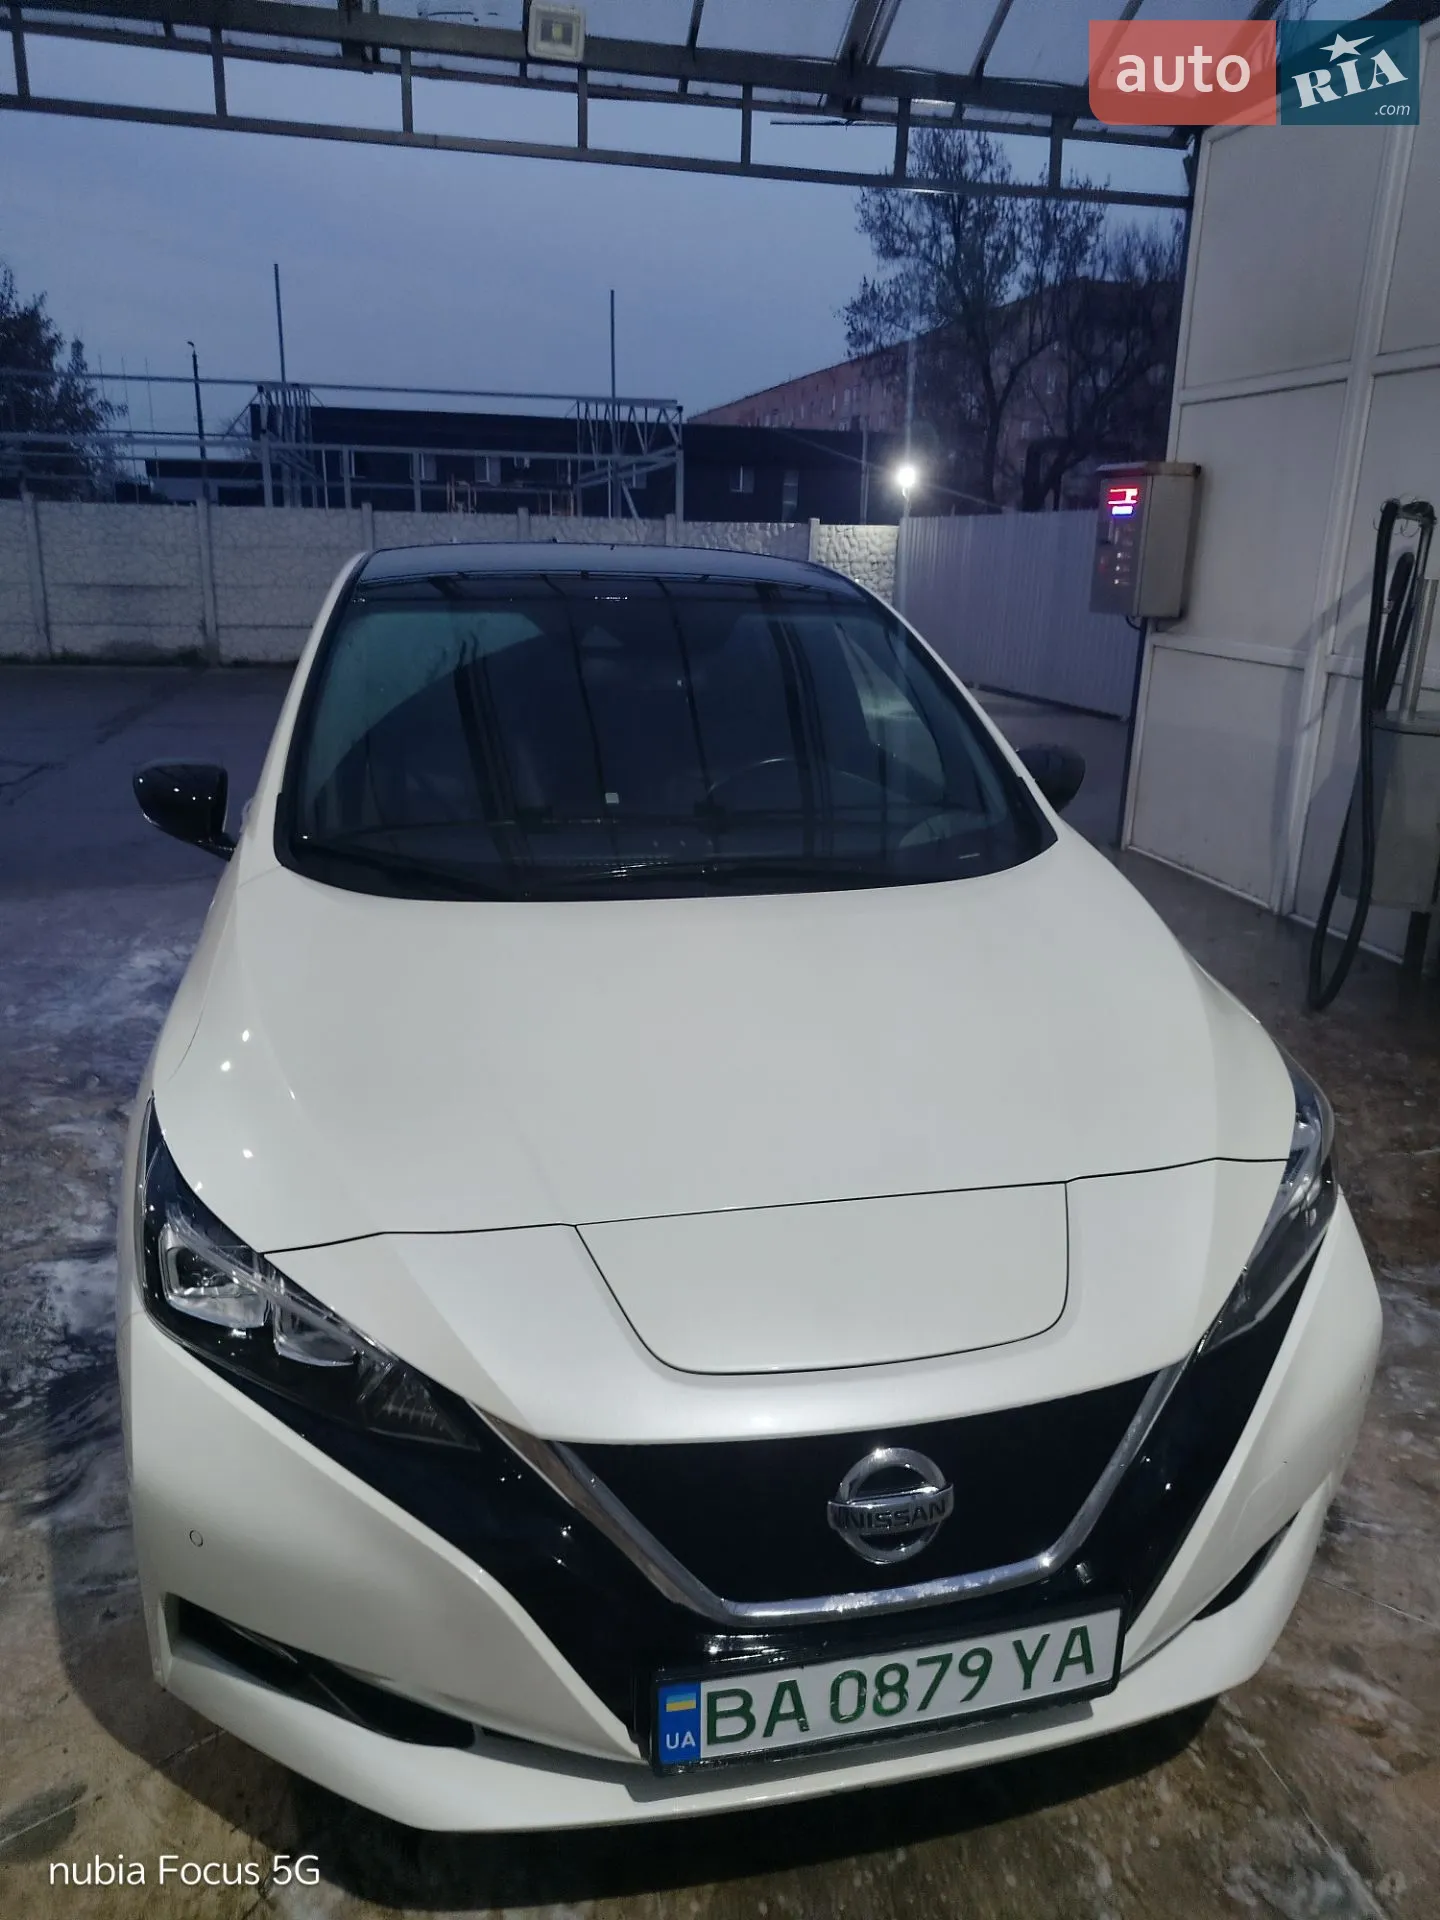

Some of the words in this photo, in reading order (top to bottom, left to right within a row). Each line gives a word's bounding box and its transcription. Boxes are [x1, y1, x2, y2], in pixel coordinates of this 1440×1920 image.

[847, 1500, 946, 1529] NISSAN
[705, 1679, 811, 1746] BA
[829, 1646, 994, 1724] 0879
[1012, 1624, 1096, 1691] YA
[665, 1730, 697, 1750] UA
